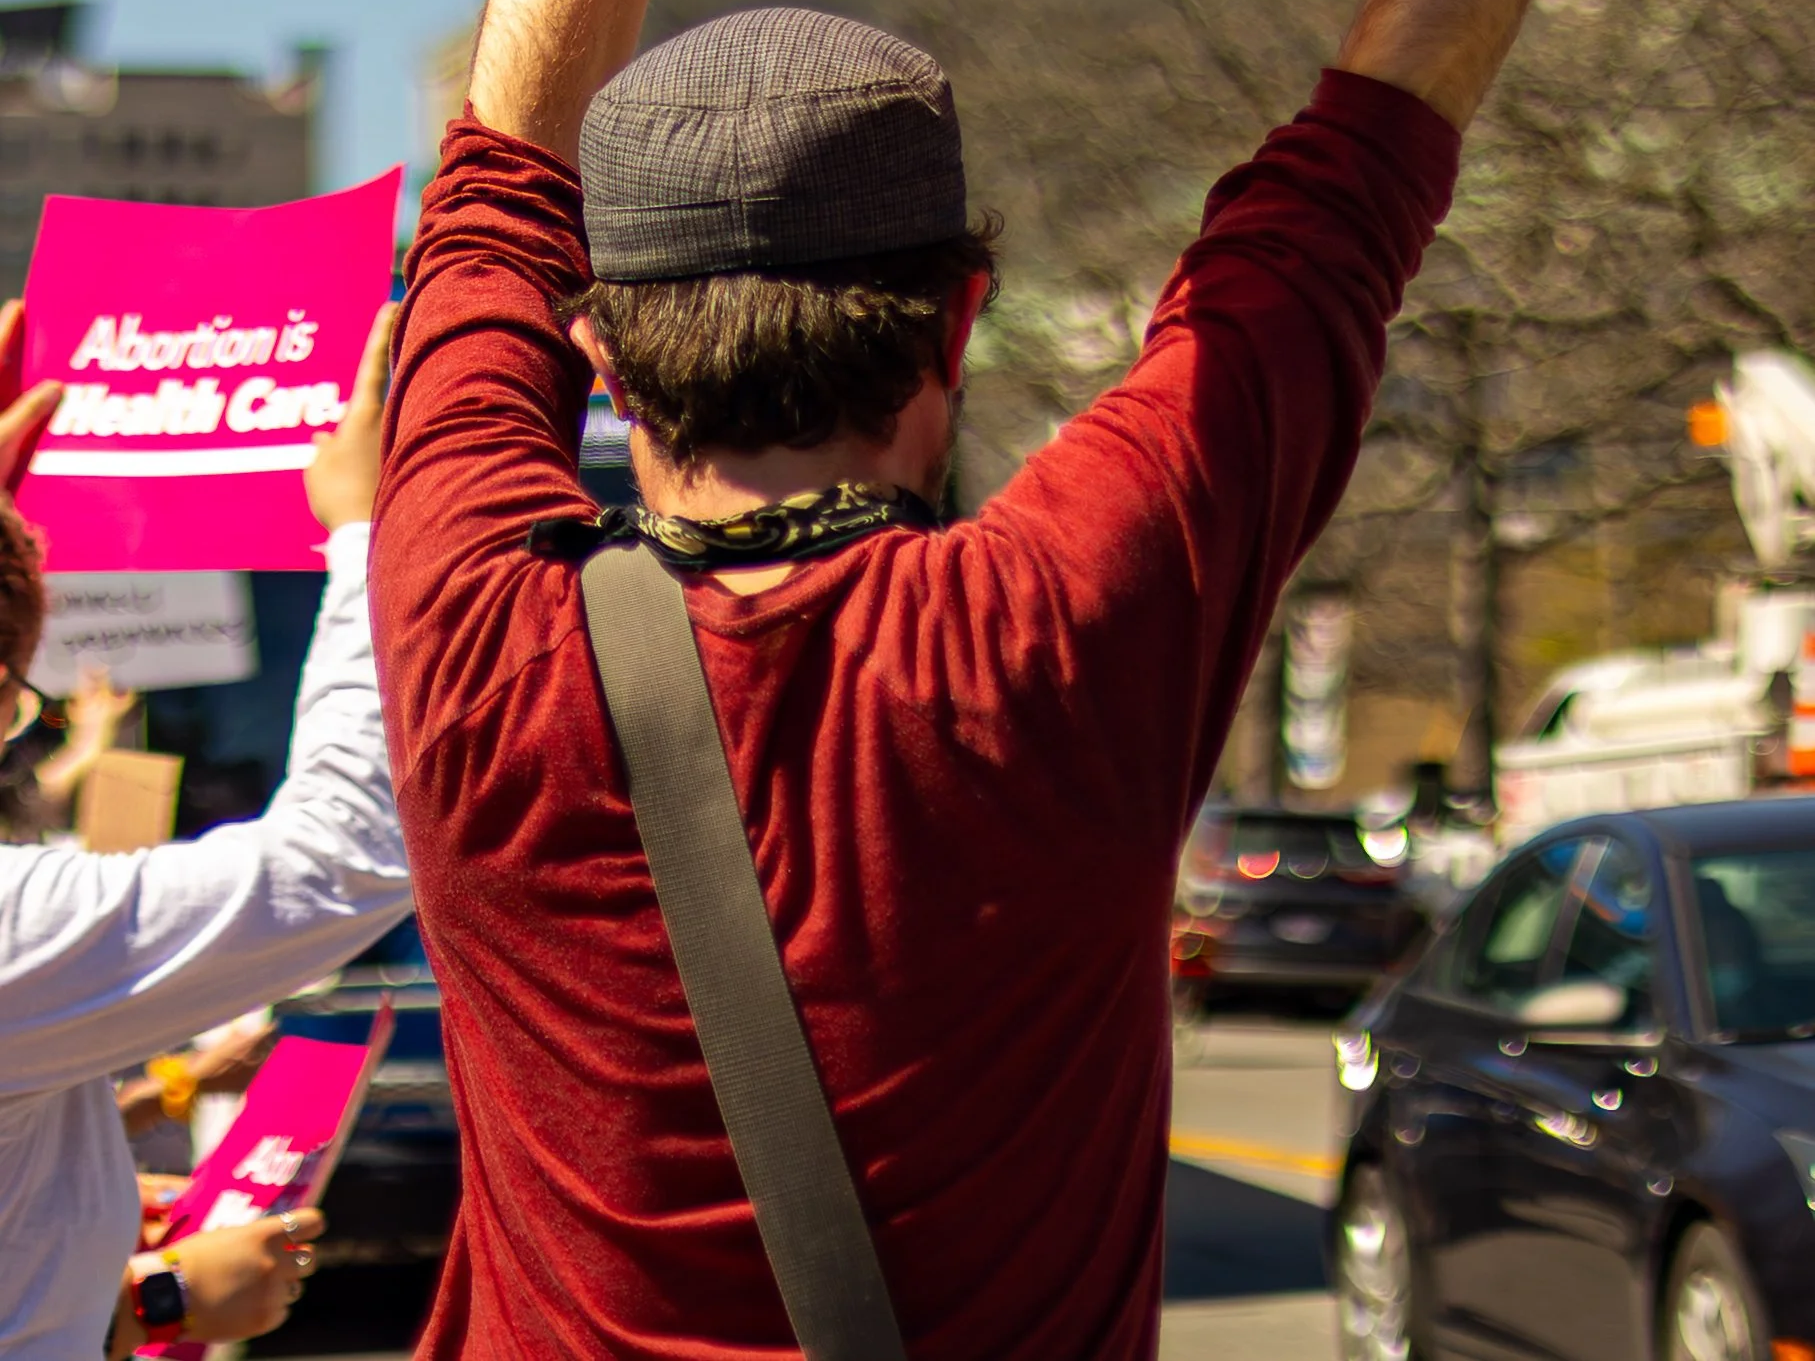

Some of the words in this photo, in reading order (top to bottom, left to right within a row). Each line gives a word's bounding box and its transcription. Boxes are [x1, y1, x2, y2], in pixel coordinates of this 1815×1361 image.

[69, 312, 277, 372] Abortion
[275, 308, 319, 363] is
[49, 377, 226, 436] Health
